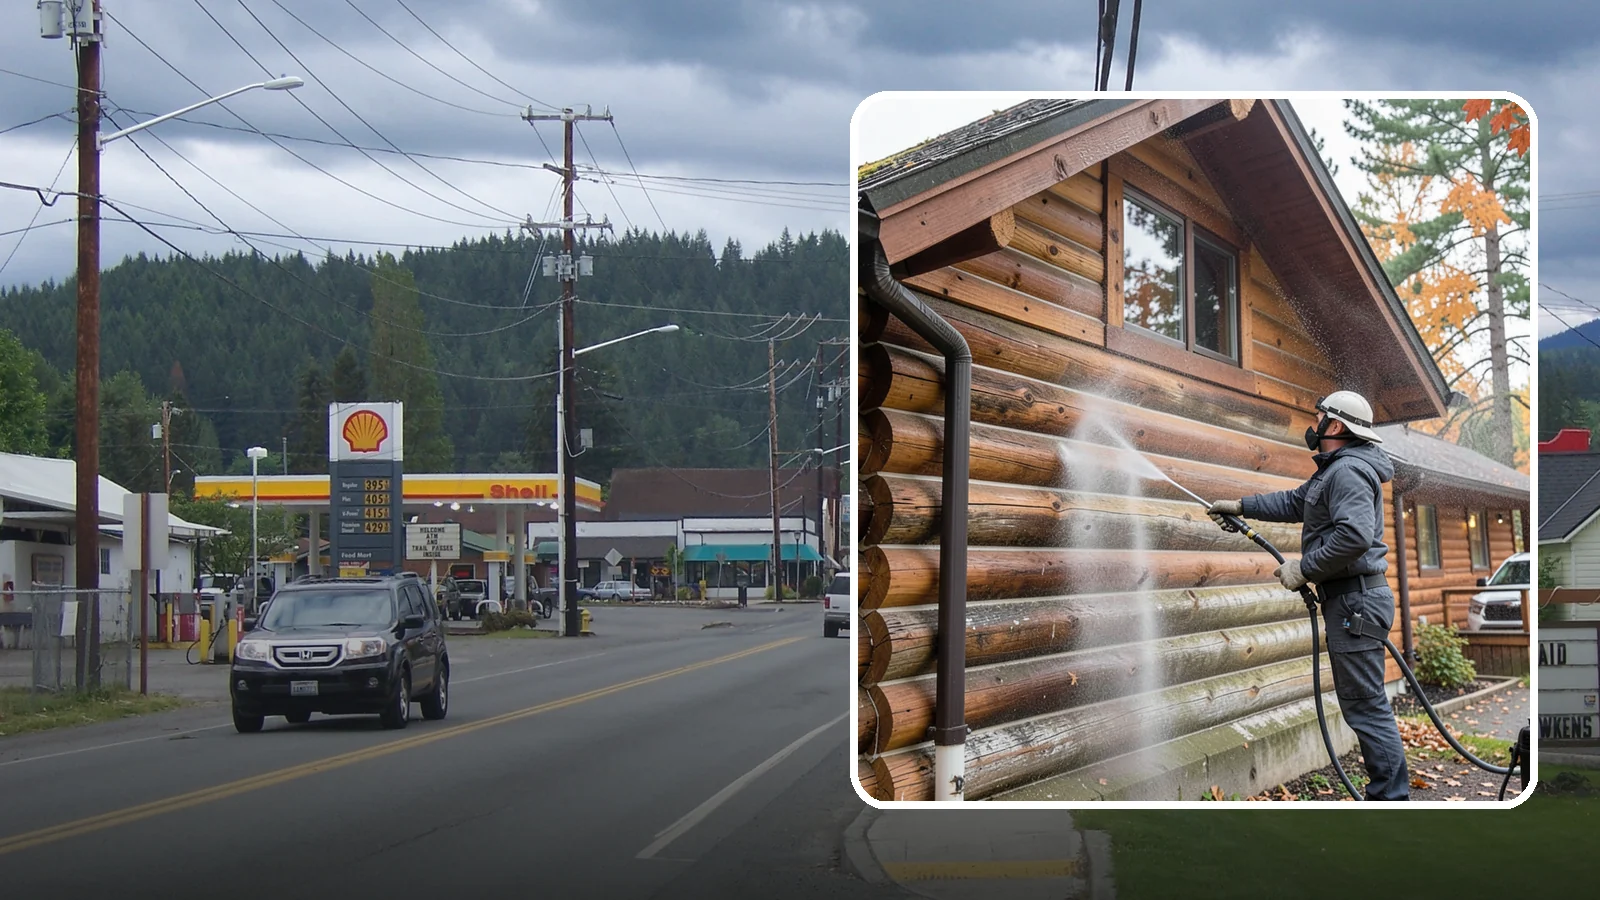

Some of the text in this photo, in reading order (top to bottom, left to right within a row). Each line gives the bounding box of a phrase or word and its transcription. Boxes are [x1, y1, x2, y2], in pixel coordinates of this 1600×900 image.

[366, 480, 384, 490] 395
[490, 484, 547, 499] Shell
[366, 494, 384, 504] 405
[366, 508, 383, 518] 415
[366, 522, 384, 532] 429
[1538, 643, 1567, 665] AID
